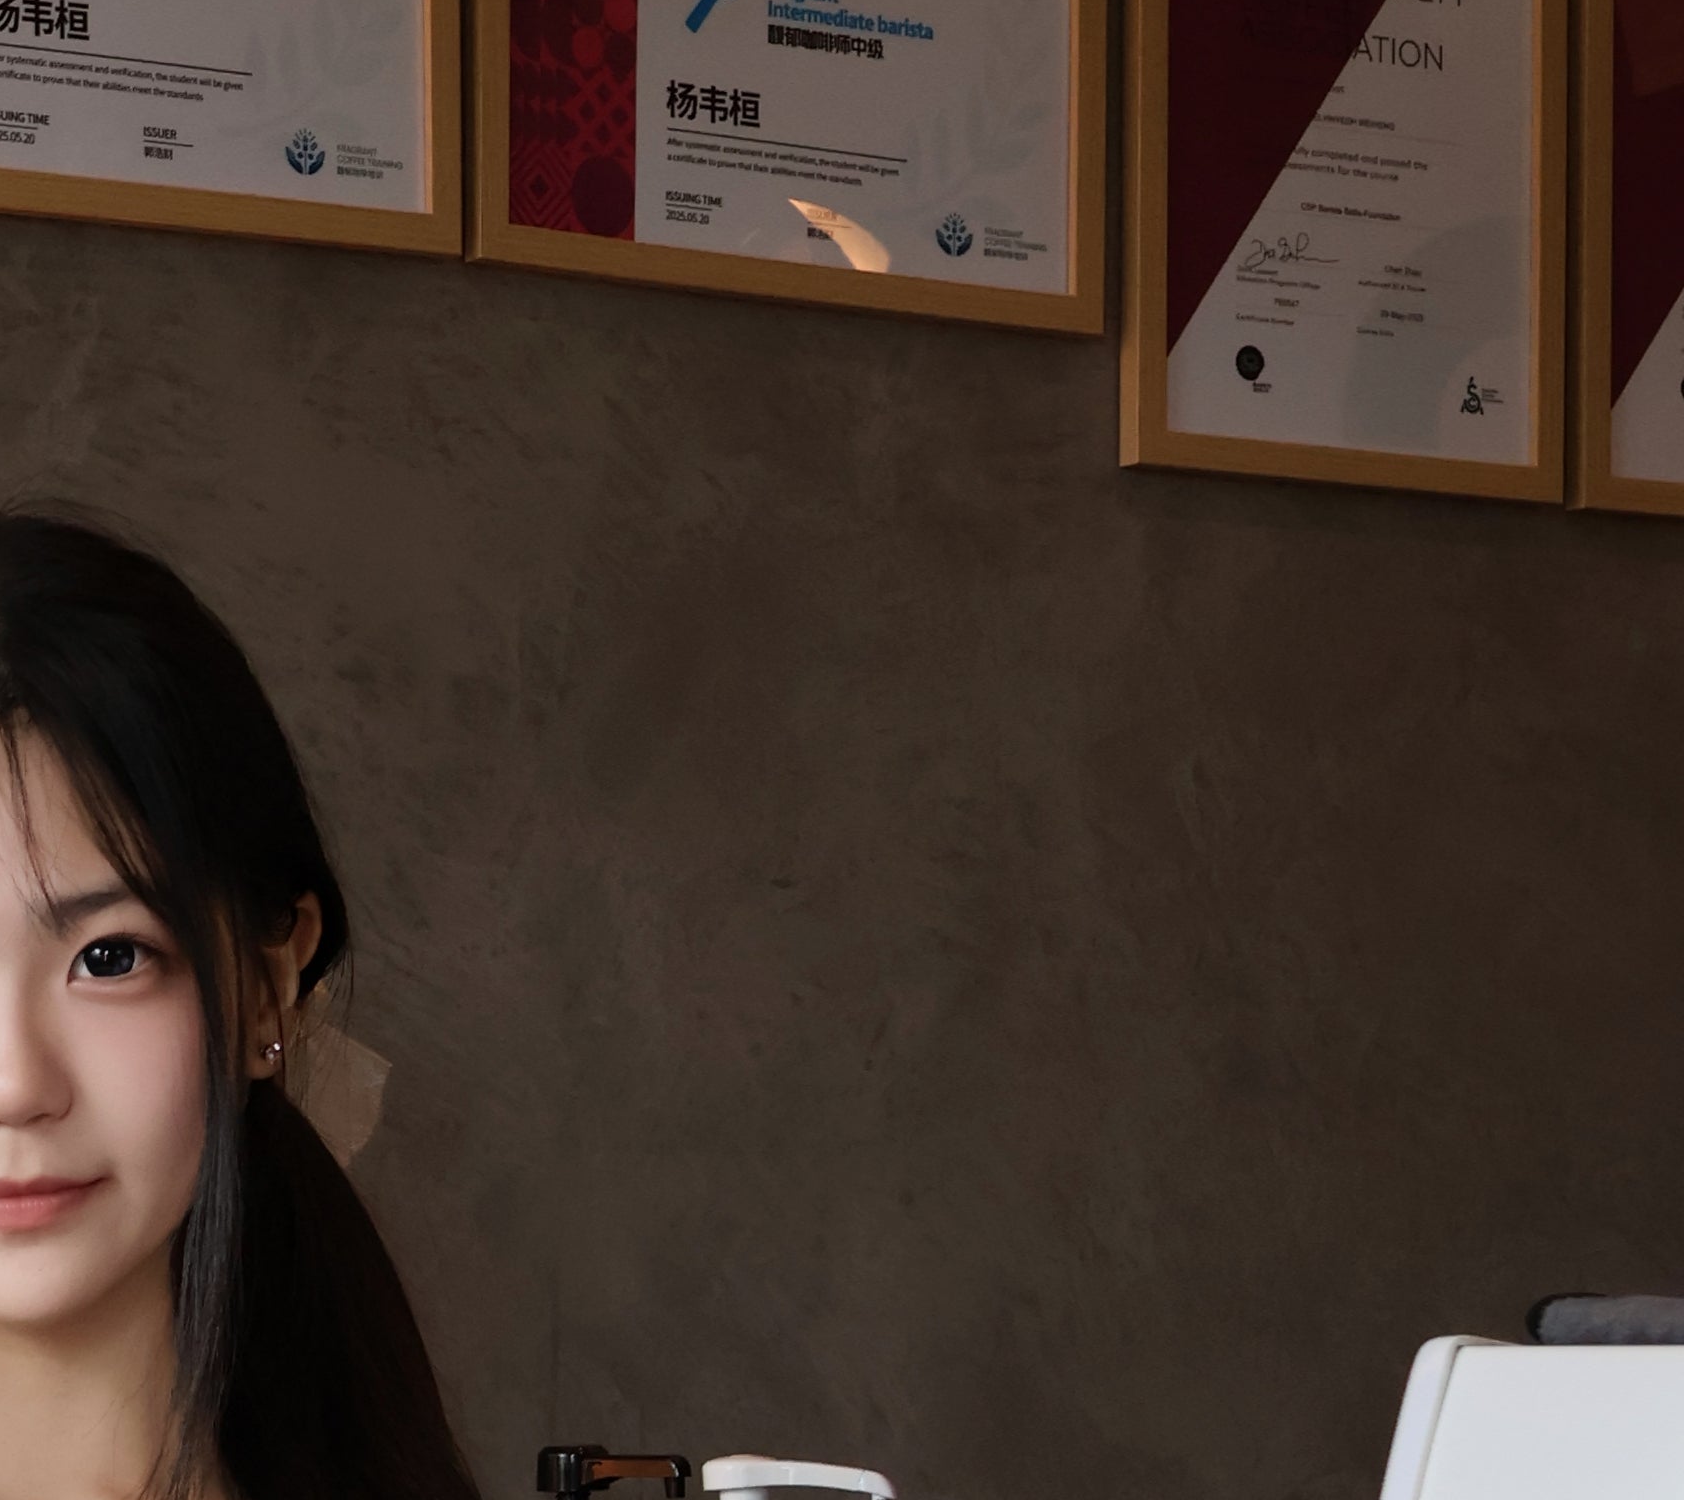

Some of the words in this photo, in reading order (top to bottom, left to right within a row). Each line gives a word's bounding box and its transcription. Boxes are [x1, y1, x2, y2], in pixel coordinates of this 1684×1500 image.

[767, 0, 876, 32] Intermediate
[877, 15, 934, 40] barista
[33, 73, 42, 82] to
[42, 75, 64, 85] prove
[65, 76, 82, 87] that
[82, 78, 101, 89] their
[94, 64, 110, 75] and
[155, 71, 168, 81] the
[168, 73, 198, 85] student
[212, 78, 222, 88] be
[223, 80, 244, 92] given
[666, 79, 761, 128] 杨韦桓
[27, 112, 50, 126] TIME
[143, 125, 177, 140] ISSUER
[665, 190, 701, 205] ISSUING
[665, 209, 710, 225] 2025.05.20
